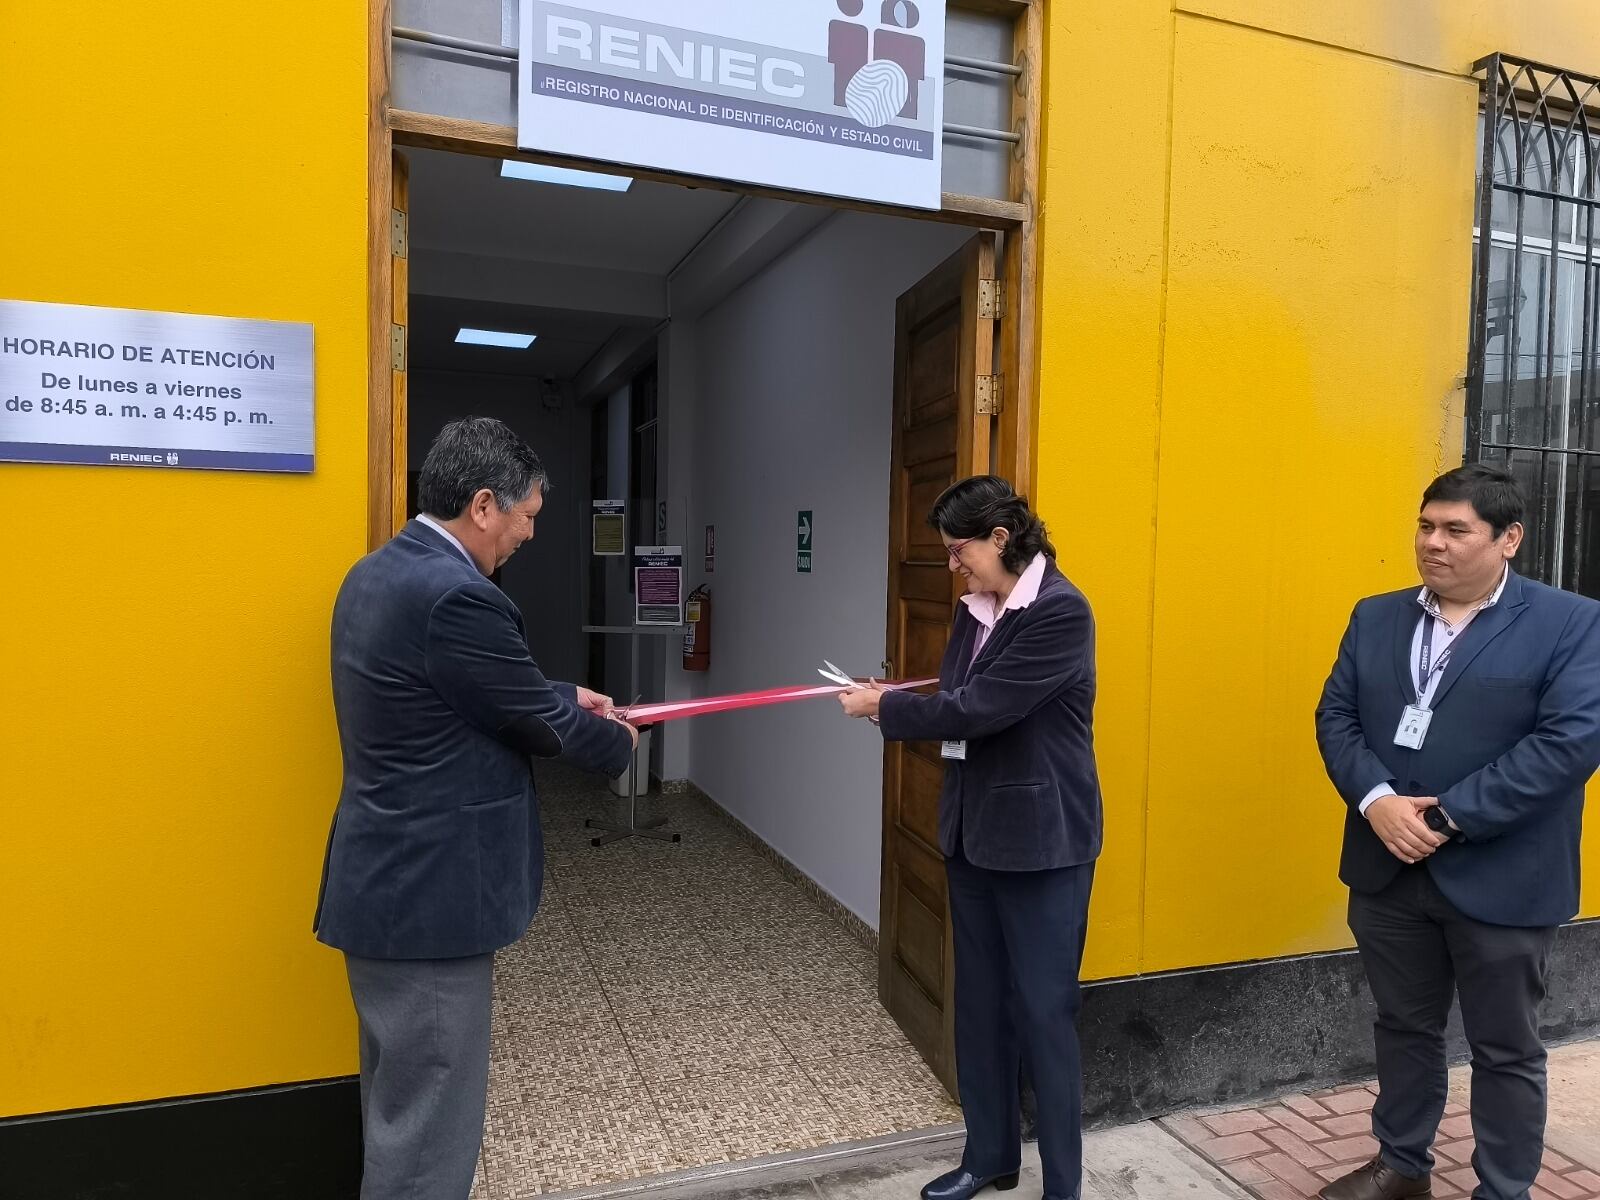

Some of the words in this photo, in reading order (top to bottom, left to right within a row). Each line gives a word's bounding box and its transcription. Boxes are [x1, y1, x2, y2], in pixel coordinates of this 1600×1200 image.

[546, 14, 805, 98] RENIEC
[545, 76, 620, 101] REGISTRO
[624, 90, 696, 115] NACIONAL
[700, 103, 718, 118] DE
[721, 107, 824, 136] IDENTIFICACIÓN
[829, 125, 838, 138] Y
[840, 127, 890, 147] ESTADO
[893, 136, 923, 152] CIVIL
[3, 336, 115, 360] HORARIO
[122, 345, 153, 363] DE
[161, 349, 275, 371] ATENCIÓN
[41, 372, 71, 390] De
[78, 375, 138, 394] lunes
[145, 382, 158, 395] a
[165, 381, 242, 400] viernes
[5, 395, 33, 413] de
[40, 397, 87, 415] 8:45
[95, 403, 113, 417] a.
[121, 405, 147, 419] m.
[154, 407, 166, 420] a
[172, 404, 217, 422] 4:45
[224, 410, 242, 426] p.
[249, 411, 274, 425] m.
[110, 453, 163, 463] RENIEC
